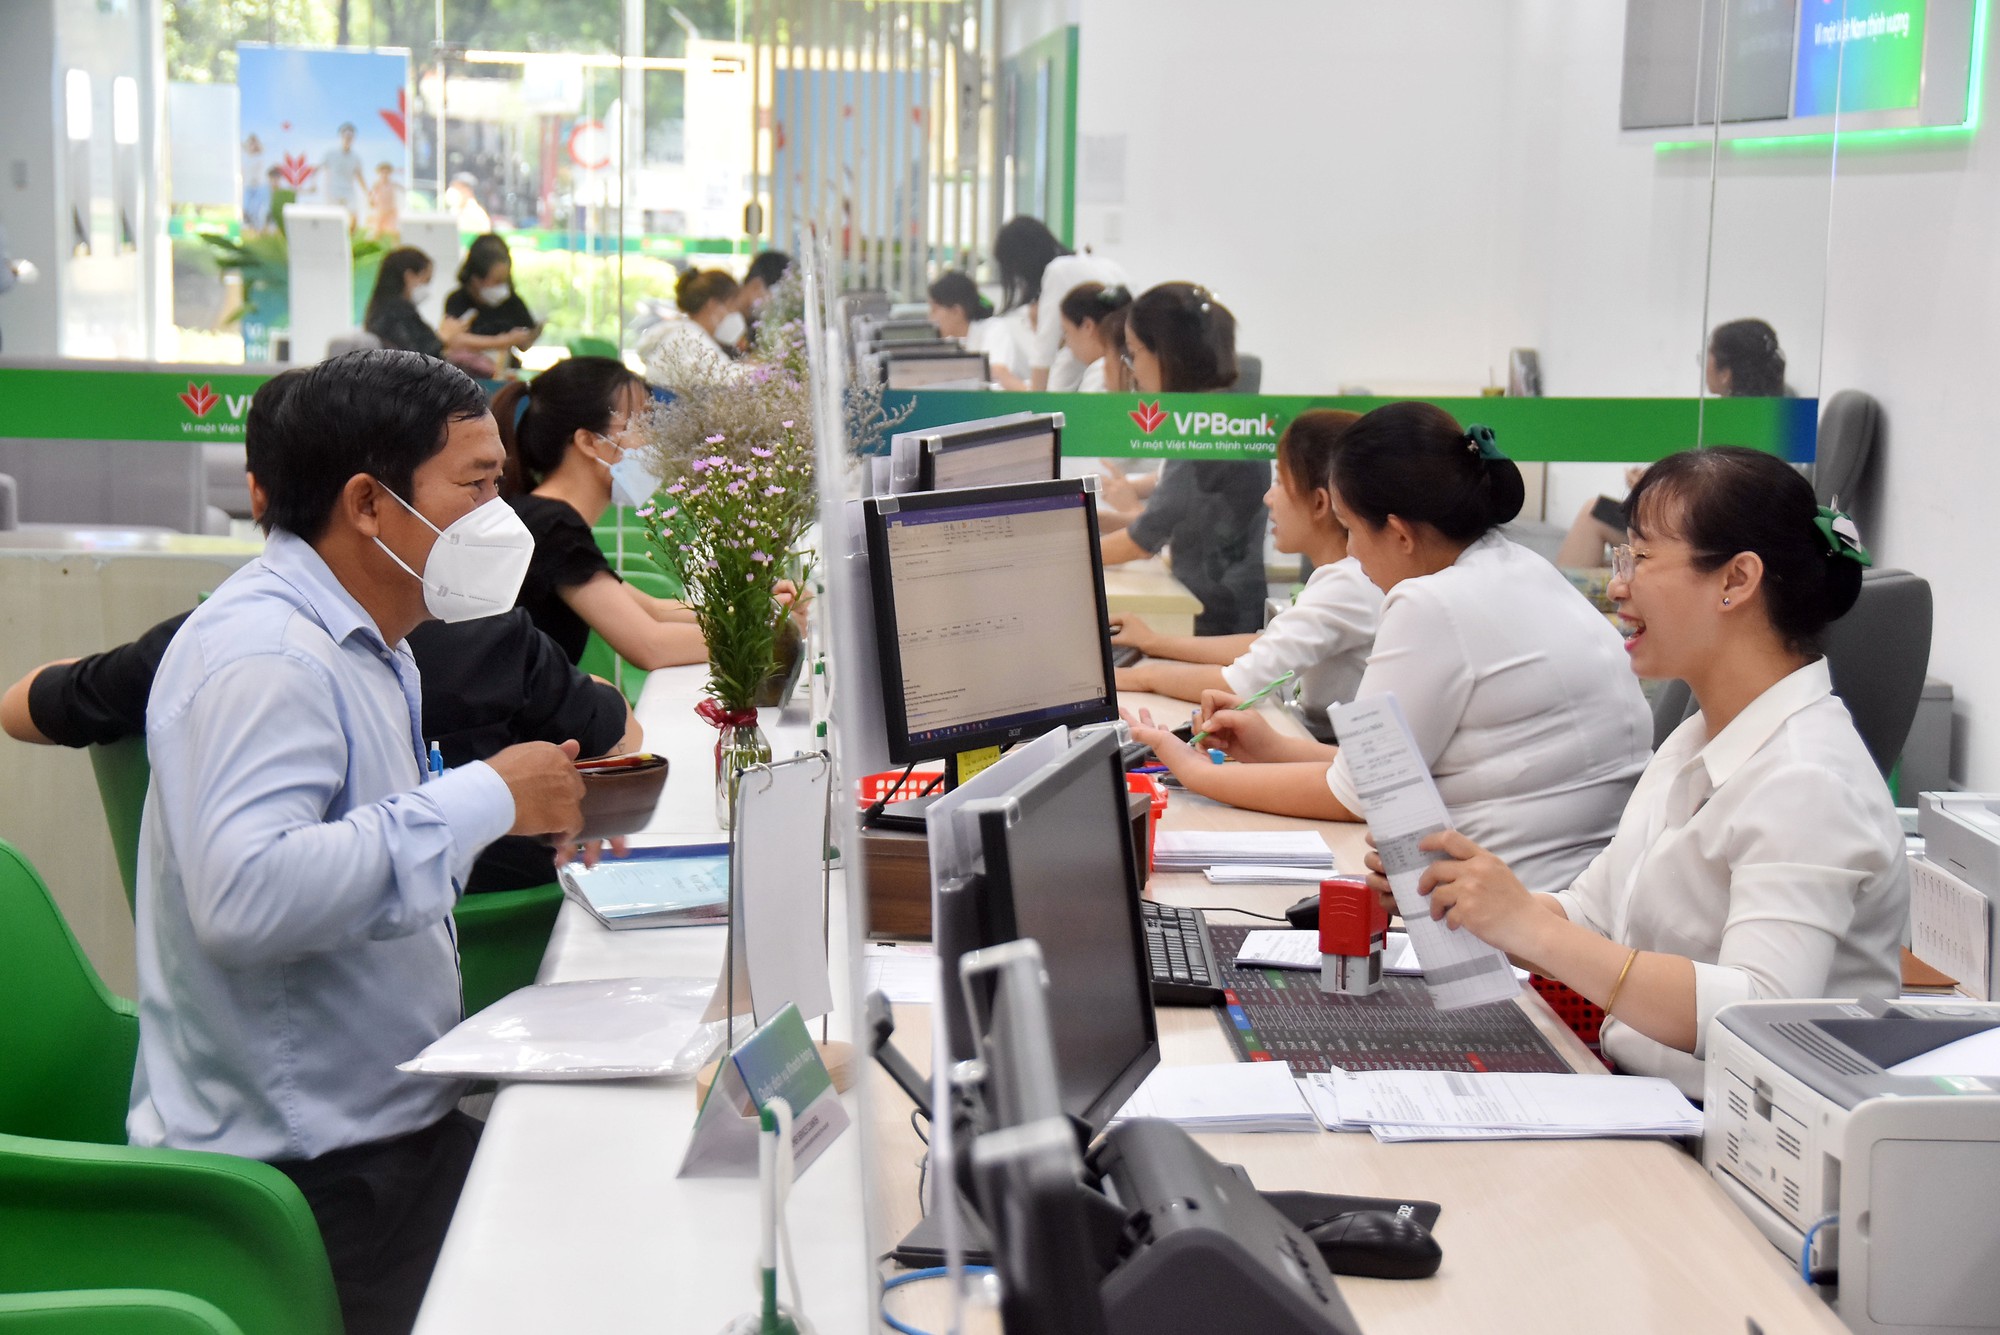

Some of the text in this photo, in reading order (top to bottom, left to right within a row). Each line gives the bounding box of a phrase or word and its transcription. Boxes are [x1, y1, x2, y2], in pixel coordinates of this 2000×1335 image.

[1850, 16, 1867, 40] Nam
[1173, 411, 1276, 436] VPBank
[1130, 439, 1276, 453] Vì một Việt Nam thịnh vượng
